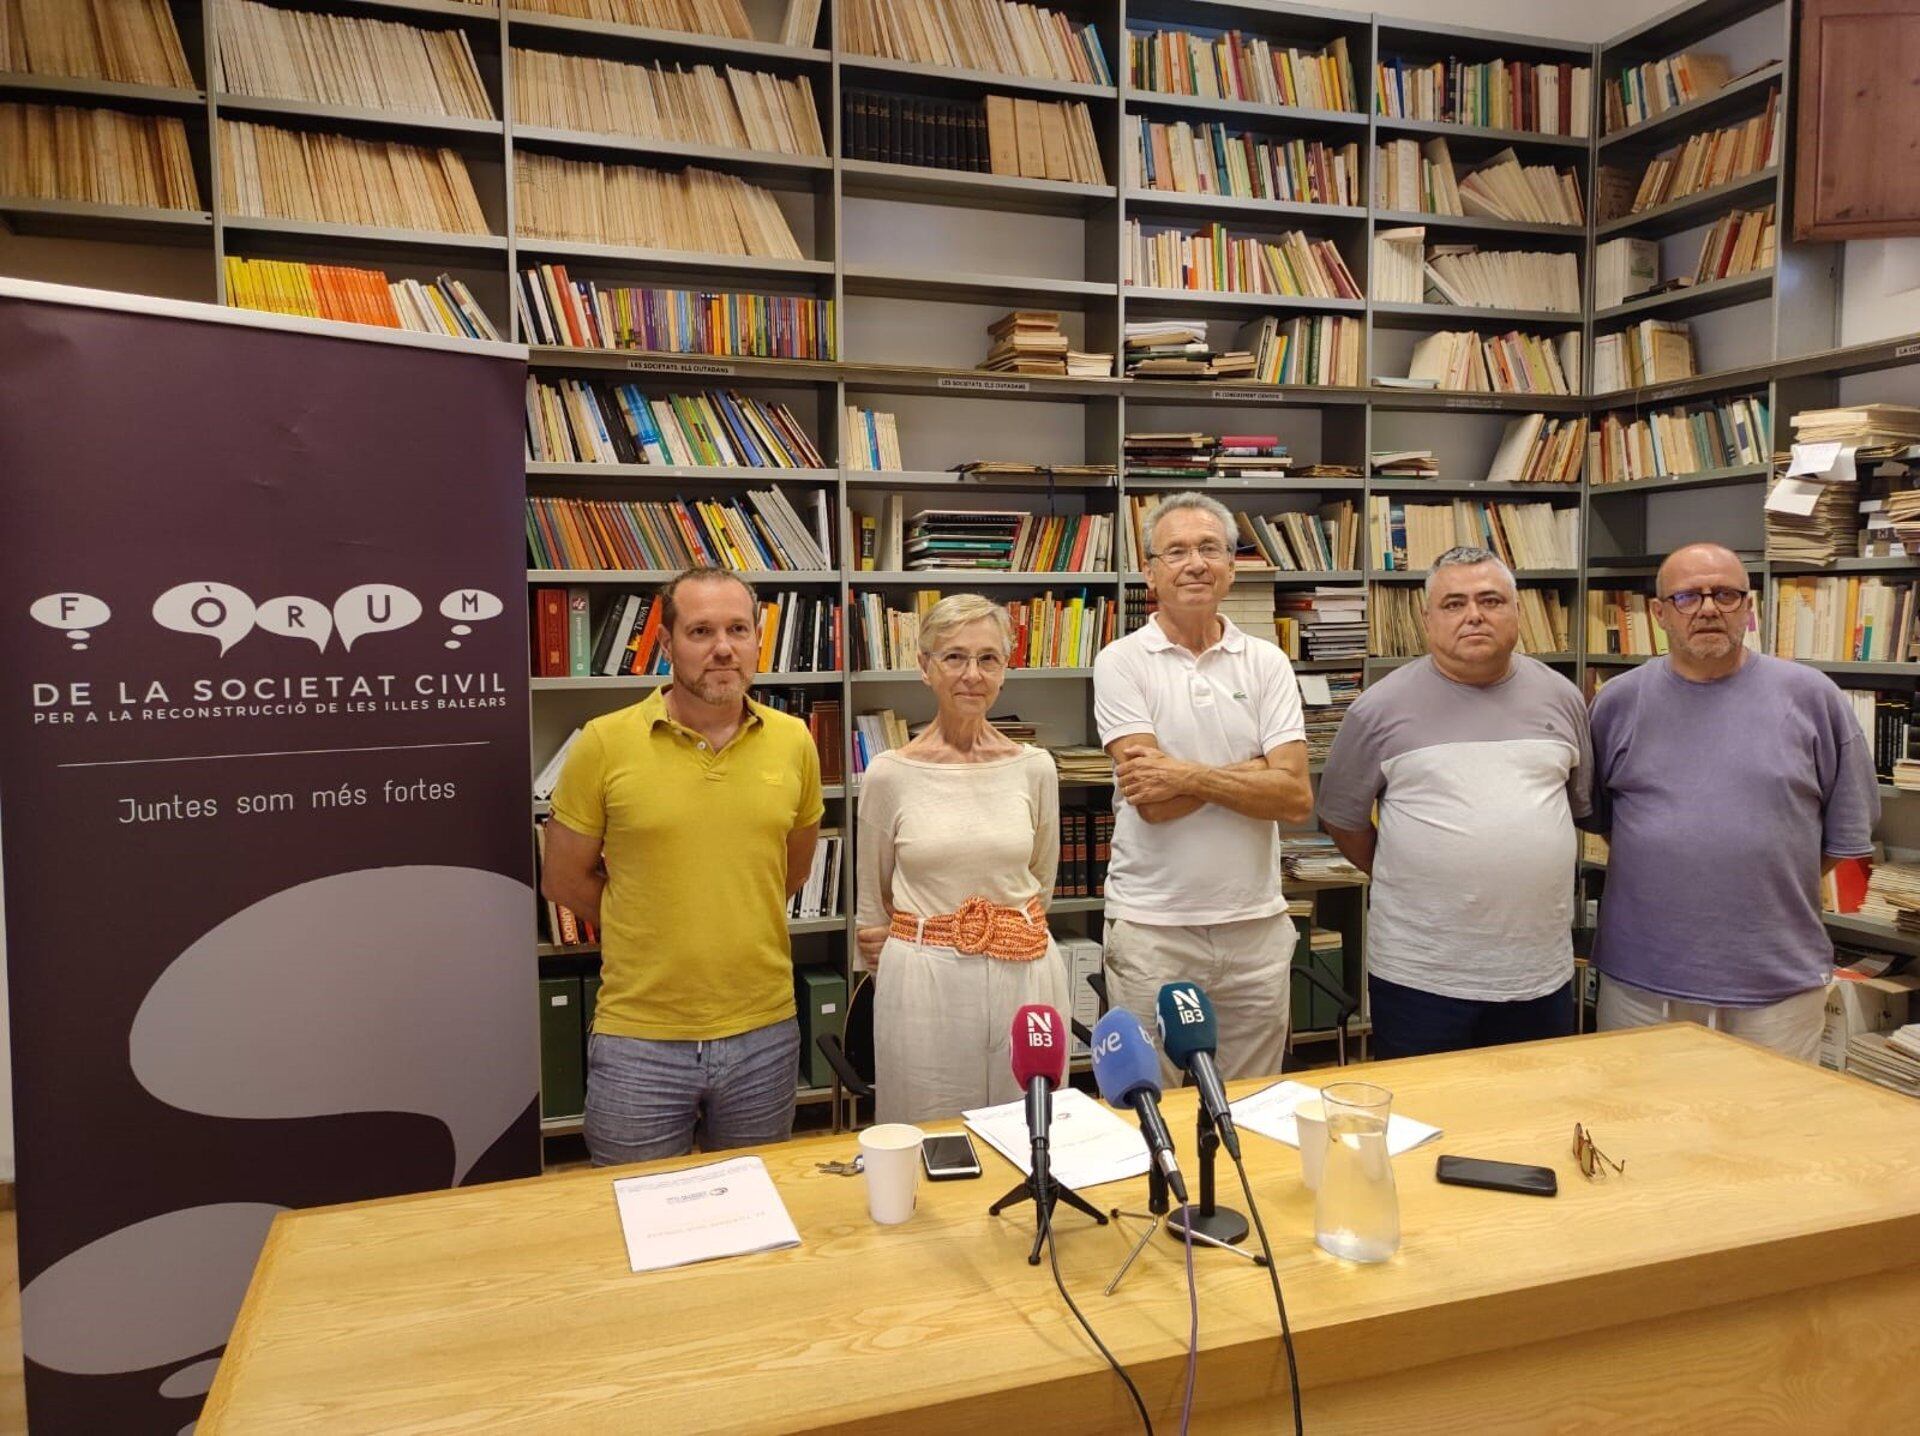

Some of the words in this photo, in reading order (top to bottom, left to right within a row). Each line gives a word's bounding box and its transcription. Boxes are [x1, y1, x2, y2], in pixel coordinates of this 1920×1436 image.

[33, 682, 92, 707] DE
[118, 681, 170, 705] LA
[193, 674, 396, 702] SOCIETAT
[414, 672, 506, 695] CIVIL
[34, 711, 75, 725] PER
[85, 711, 99, 724] A
[109, 709, 133, 722] LA
[142, 700, 307, 720] RECONSTRUCCIÓ
[315, 702, 338, 714] DE
[346, 700, 377, 713] LES
[384, 699, 430, 711] ILLES
[437, 696, 507, 709] BALEARS
[118, 794, 218, 823] Juntes
[236, 793, 294, 815] som
[312, 783, 368, 809] més
[383, 778, 456, 804] fortes
